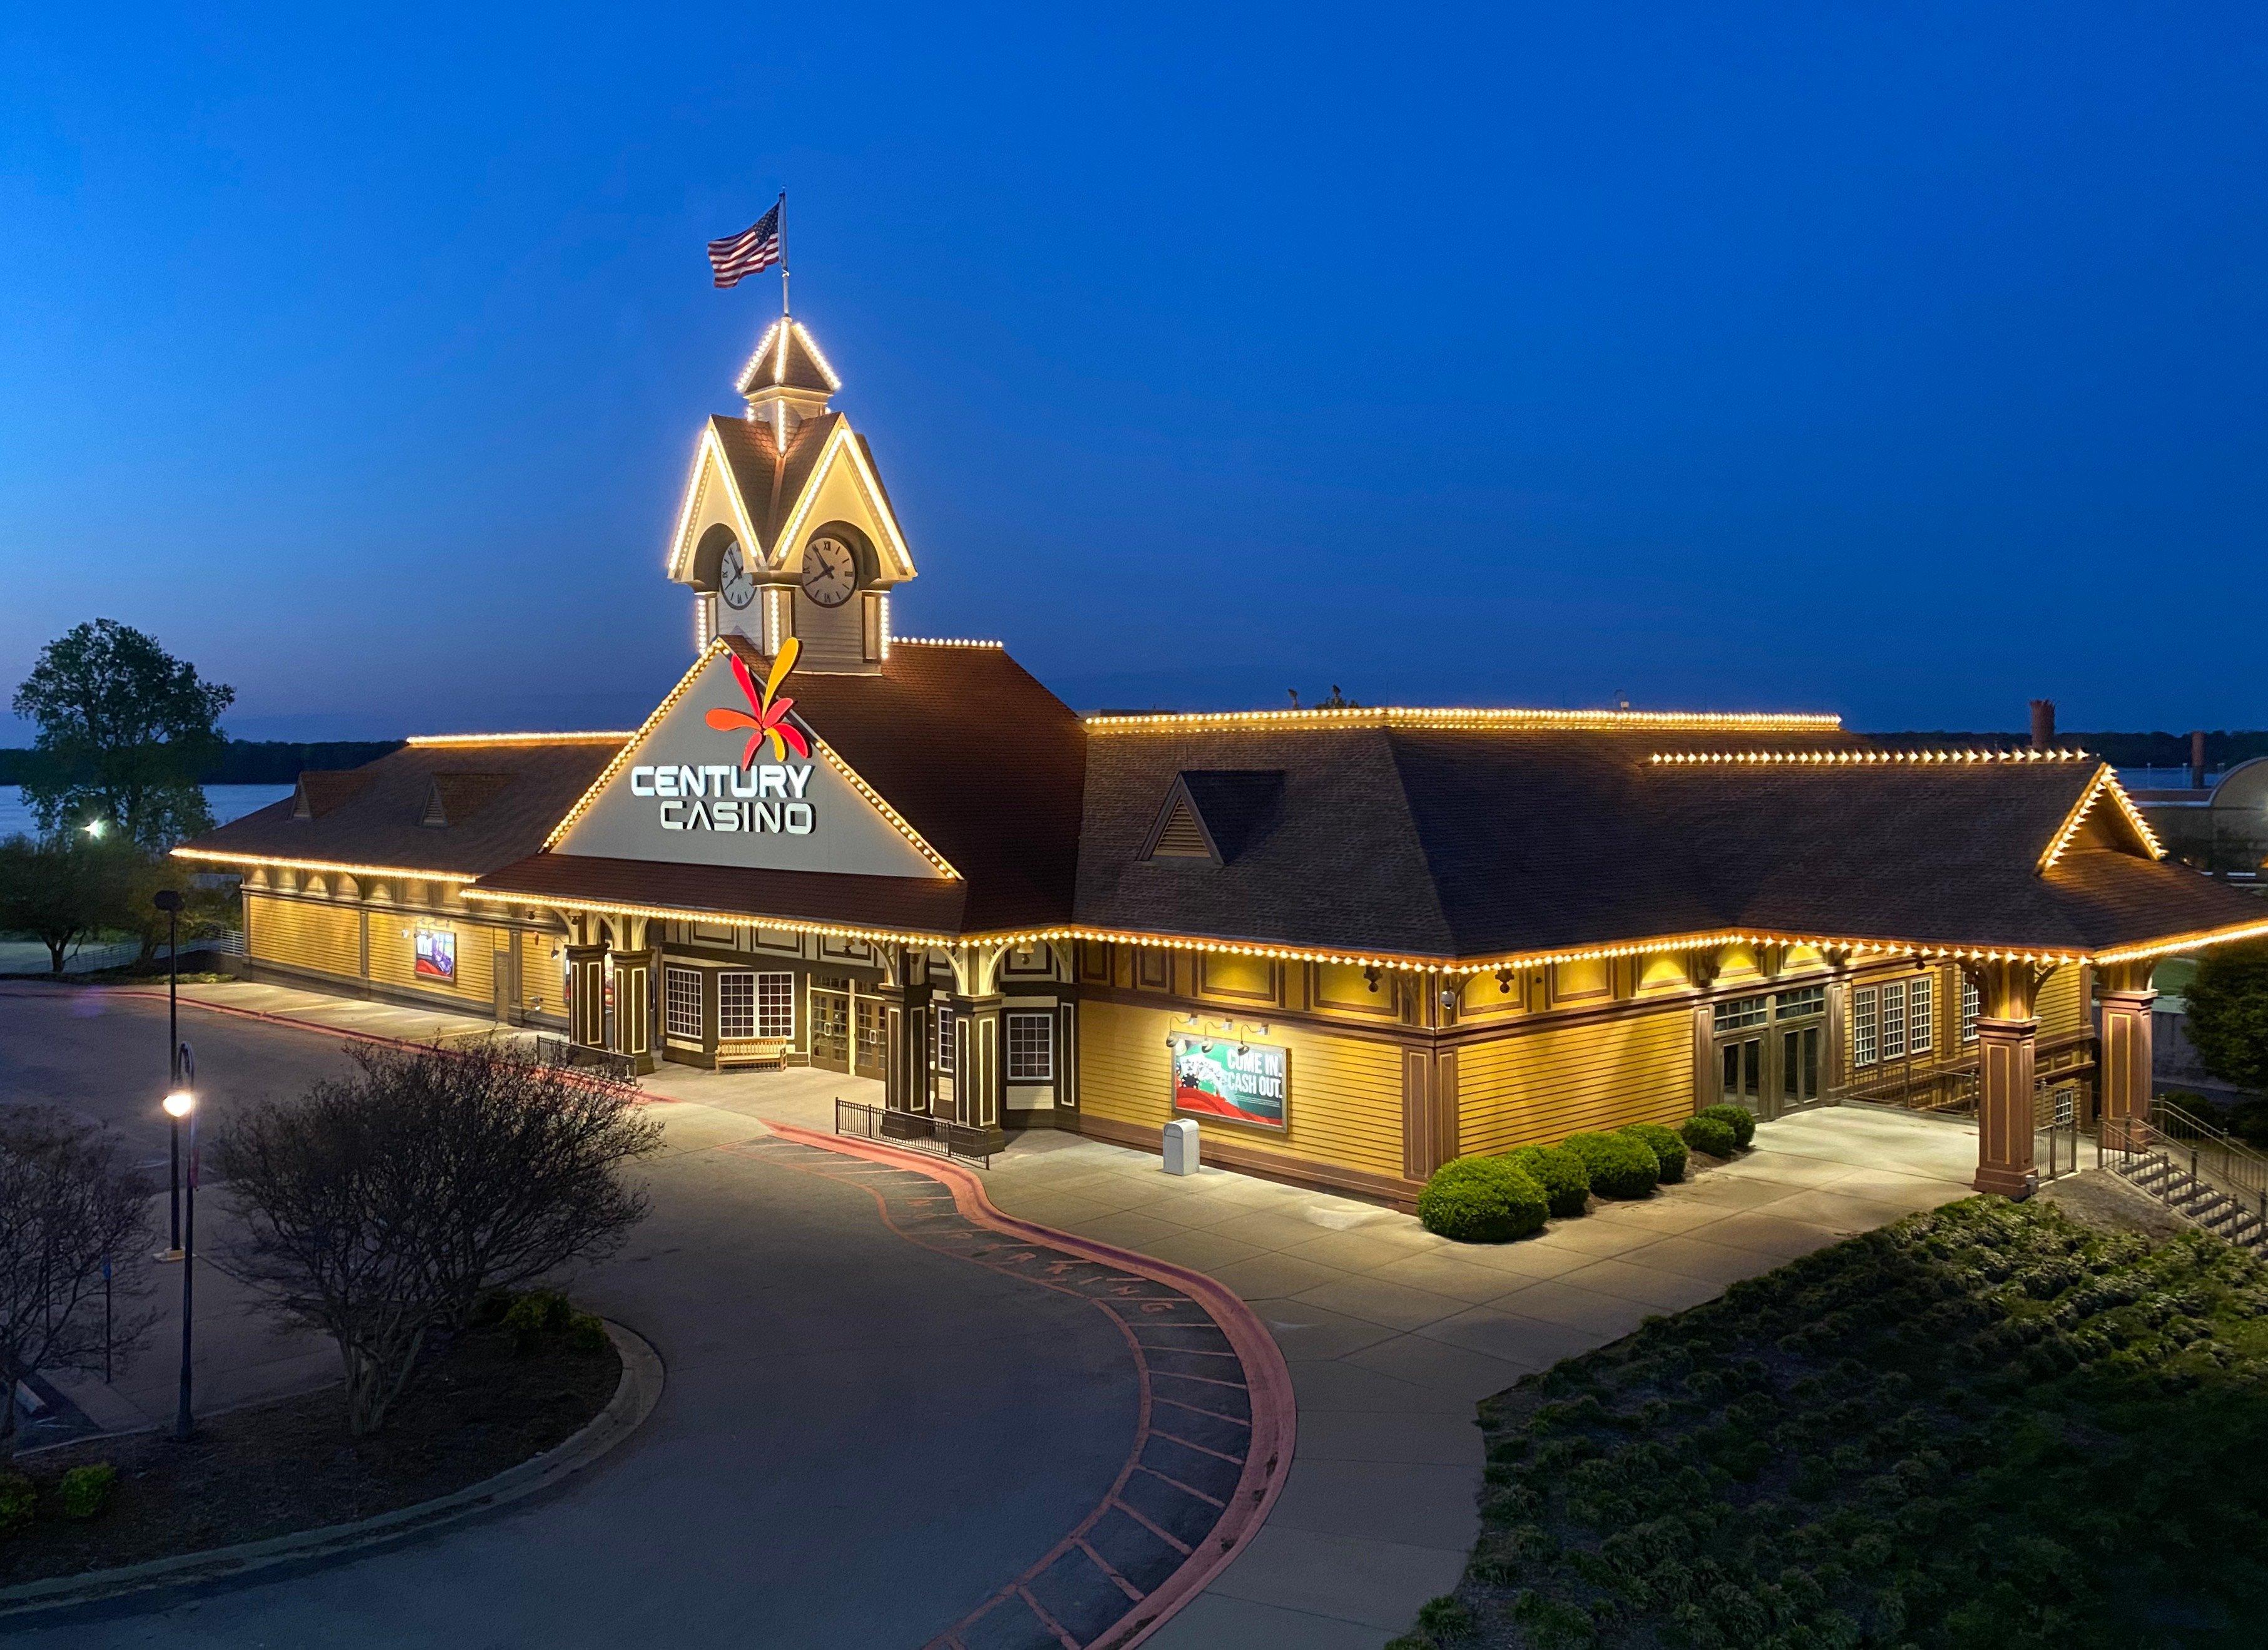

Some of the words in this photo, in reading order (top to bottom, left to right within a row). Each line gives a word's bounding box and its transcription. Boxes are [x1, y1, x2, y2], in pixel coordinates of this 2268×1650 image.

[631, 764, 813, 799] CENTURY
[660, 801, 813, 834] CASINO
[1227, 1048, 1263, 1075] COME
[1265, 1053, 1282, 1077] IN.
[1228, 1071, 1257, 1095] CASH
[1259, 1075, 1283, 1099] OUT.
